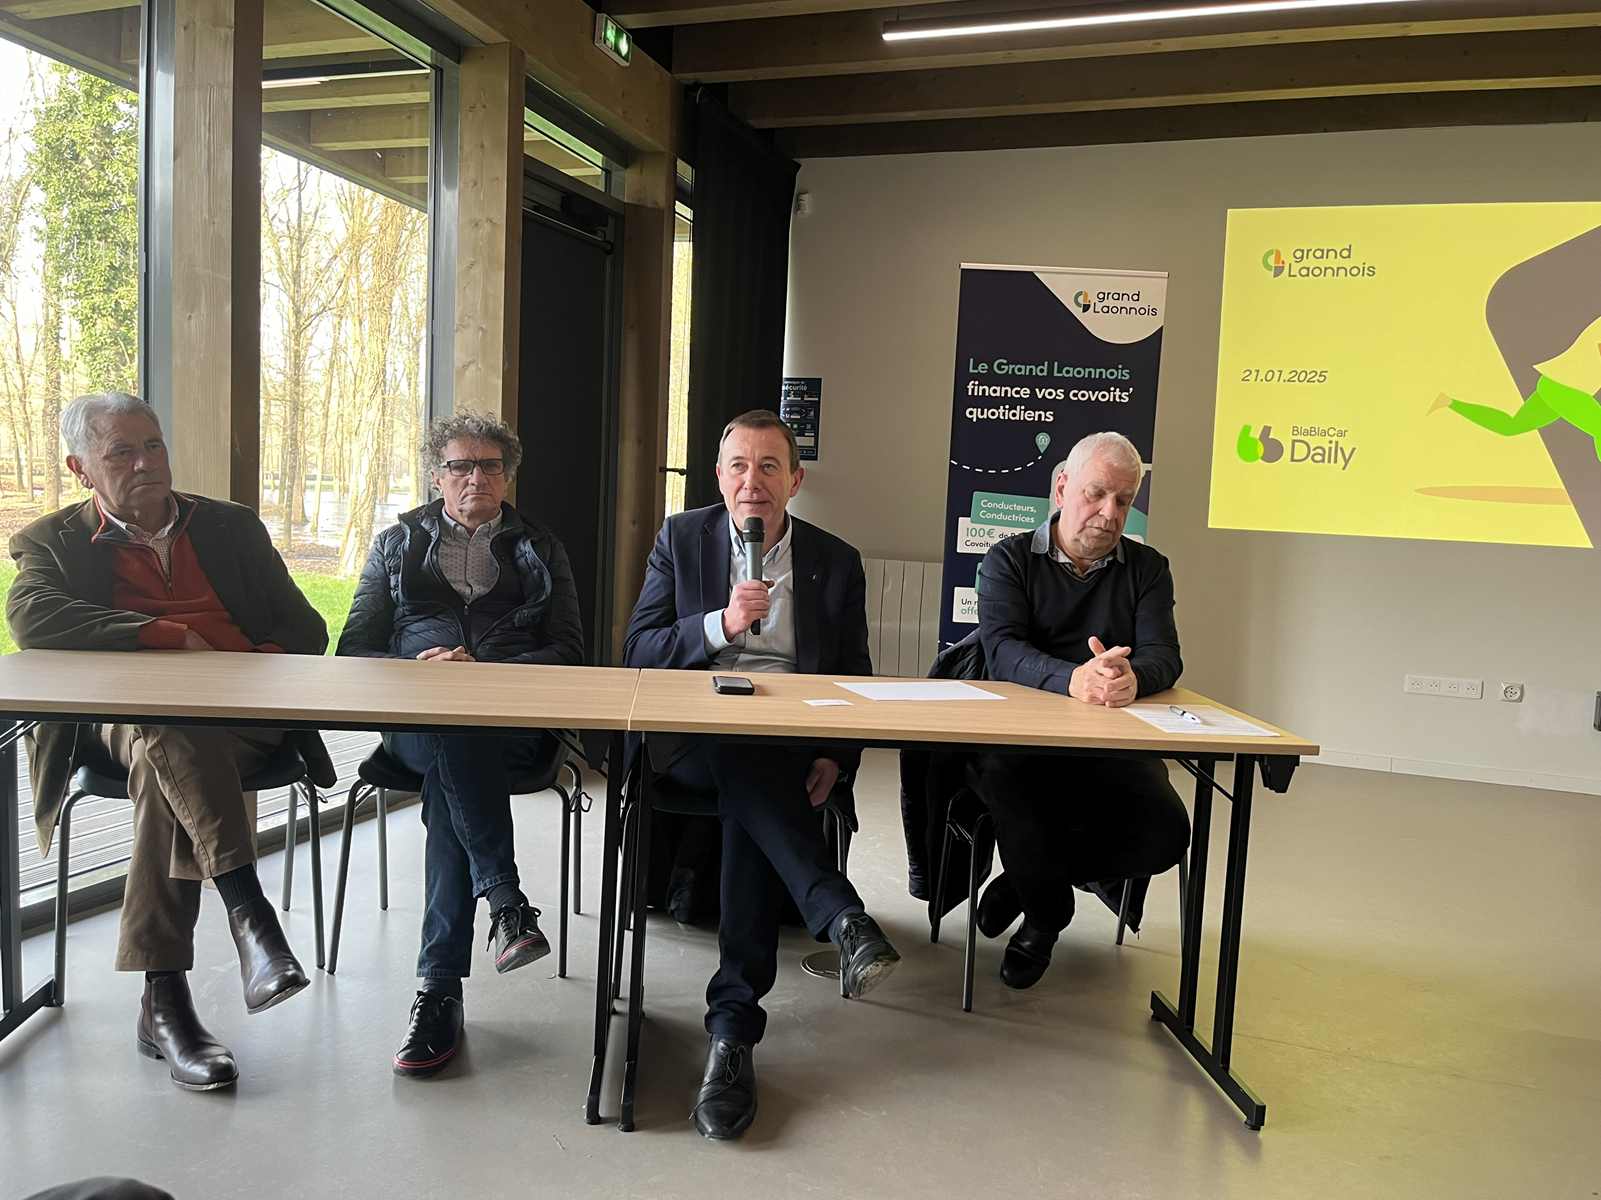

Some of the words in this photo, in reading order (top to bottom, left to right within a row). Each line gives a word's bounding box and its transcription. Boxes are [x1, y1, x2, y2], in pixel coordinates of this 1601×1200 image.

[1293, 244, 1352, 263] grand
[1288, 262, 1376, 278] Laonnois
[1096, 290, 1141, 302] grand
[1093, 302, 1158, 317] Laonnois
[968, 358, 988, 374] Le
[993, 359, 1048, 376] Grand
[1053, 362, 1131, 380] Laonnois
[1240, 368, 1329, 384] 21.01.2025
[967, 381, 1031, 399] finance
[1035, 387, 1065, 400] vos
[965, 405, 1054, 422] quotidiens
[1291, 425, 1348, 438] BlaBlaCar
[1290, 440, 1356, 470] Daily
[979, 510, 1035, 523] Conductrices
[961, 598, 972, 606] Un
